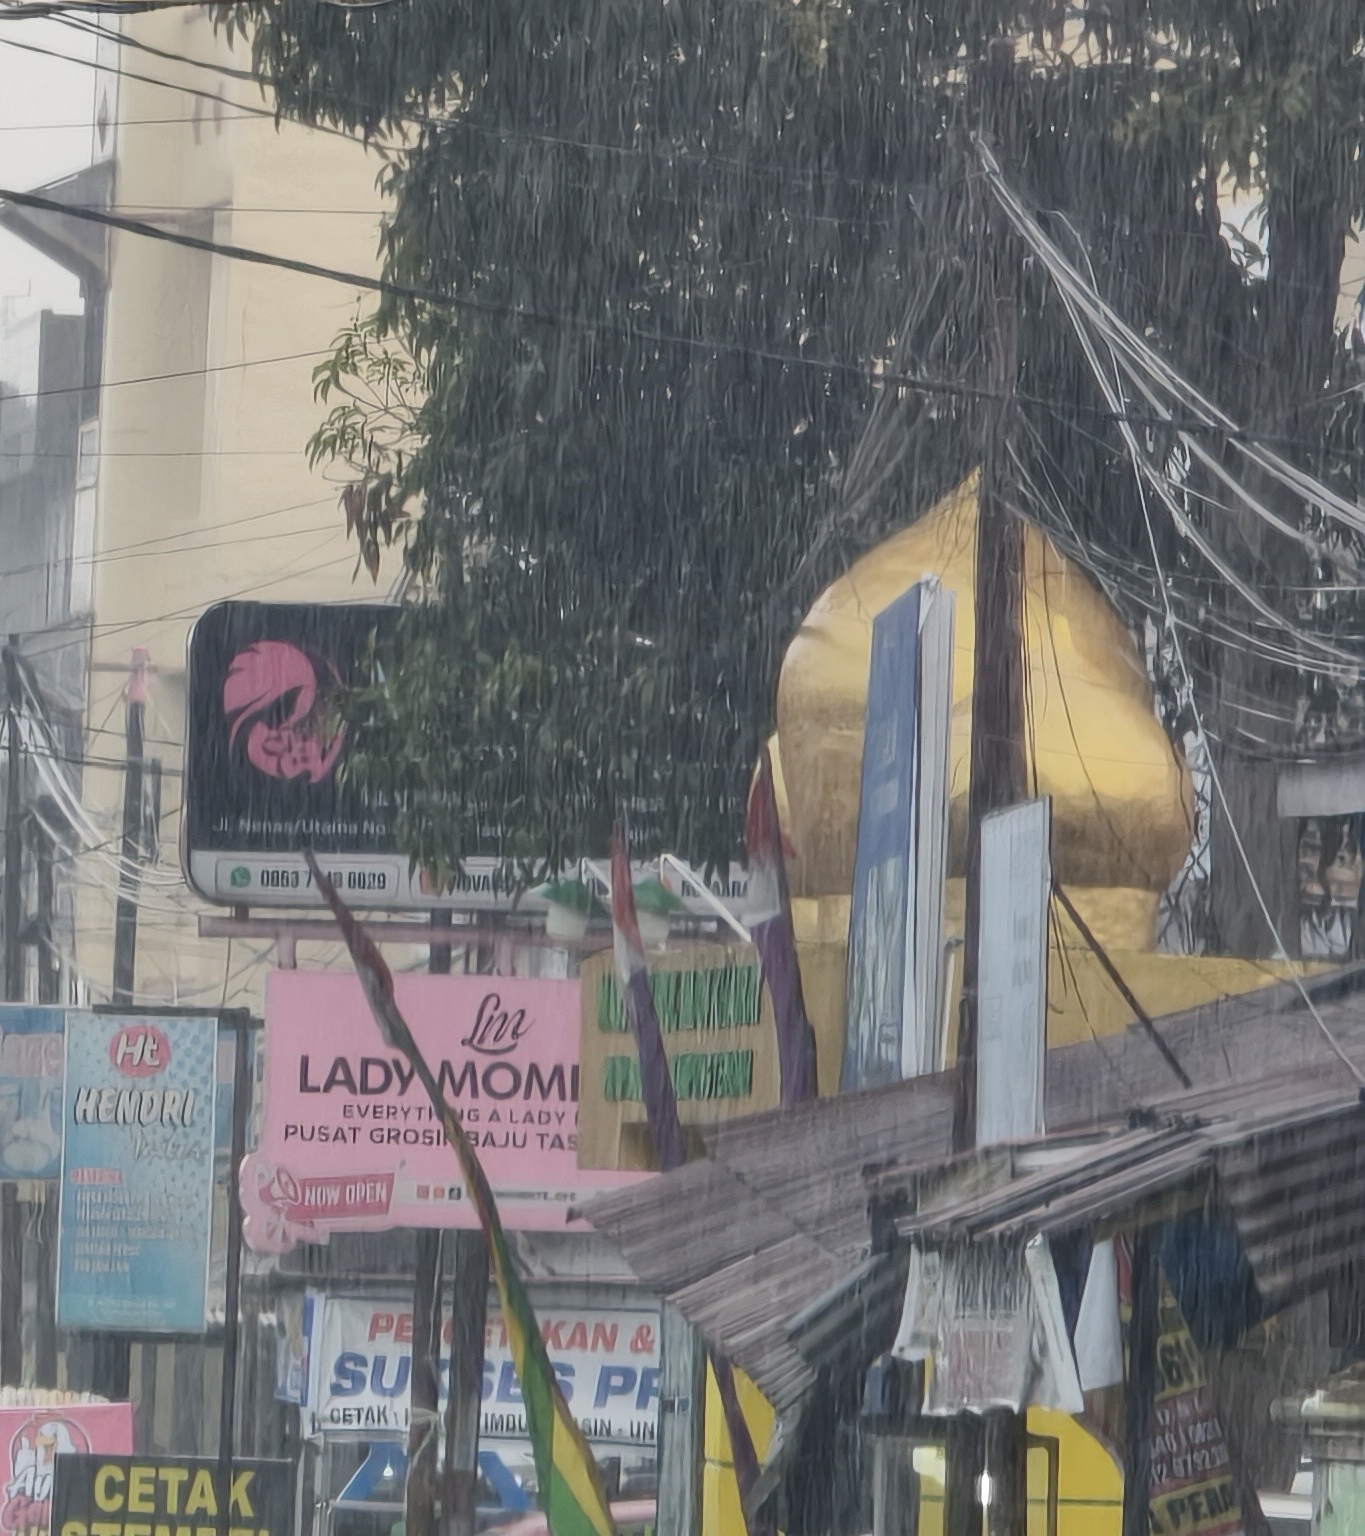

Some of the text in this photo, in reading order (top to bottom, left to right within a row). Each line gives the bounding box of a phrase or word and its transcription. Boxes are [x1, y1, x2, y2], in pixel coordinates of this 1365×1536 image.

[299, 1054, 416, 1097] LADY
[74, 1086, 195, 1128] HENDRI
[488, 1108, 503, 1123] A
[509, 1109, 566, 1126] LADY
[284, 1124, 361, 1145] PUSAT
[630, 1323, 656, 1355] &
[329, 1405, 390, 1427] CETAK
[93, 1463, 256, 1519] CETAK
